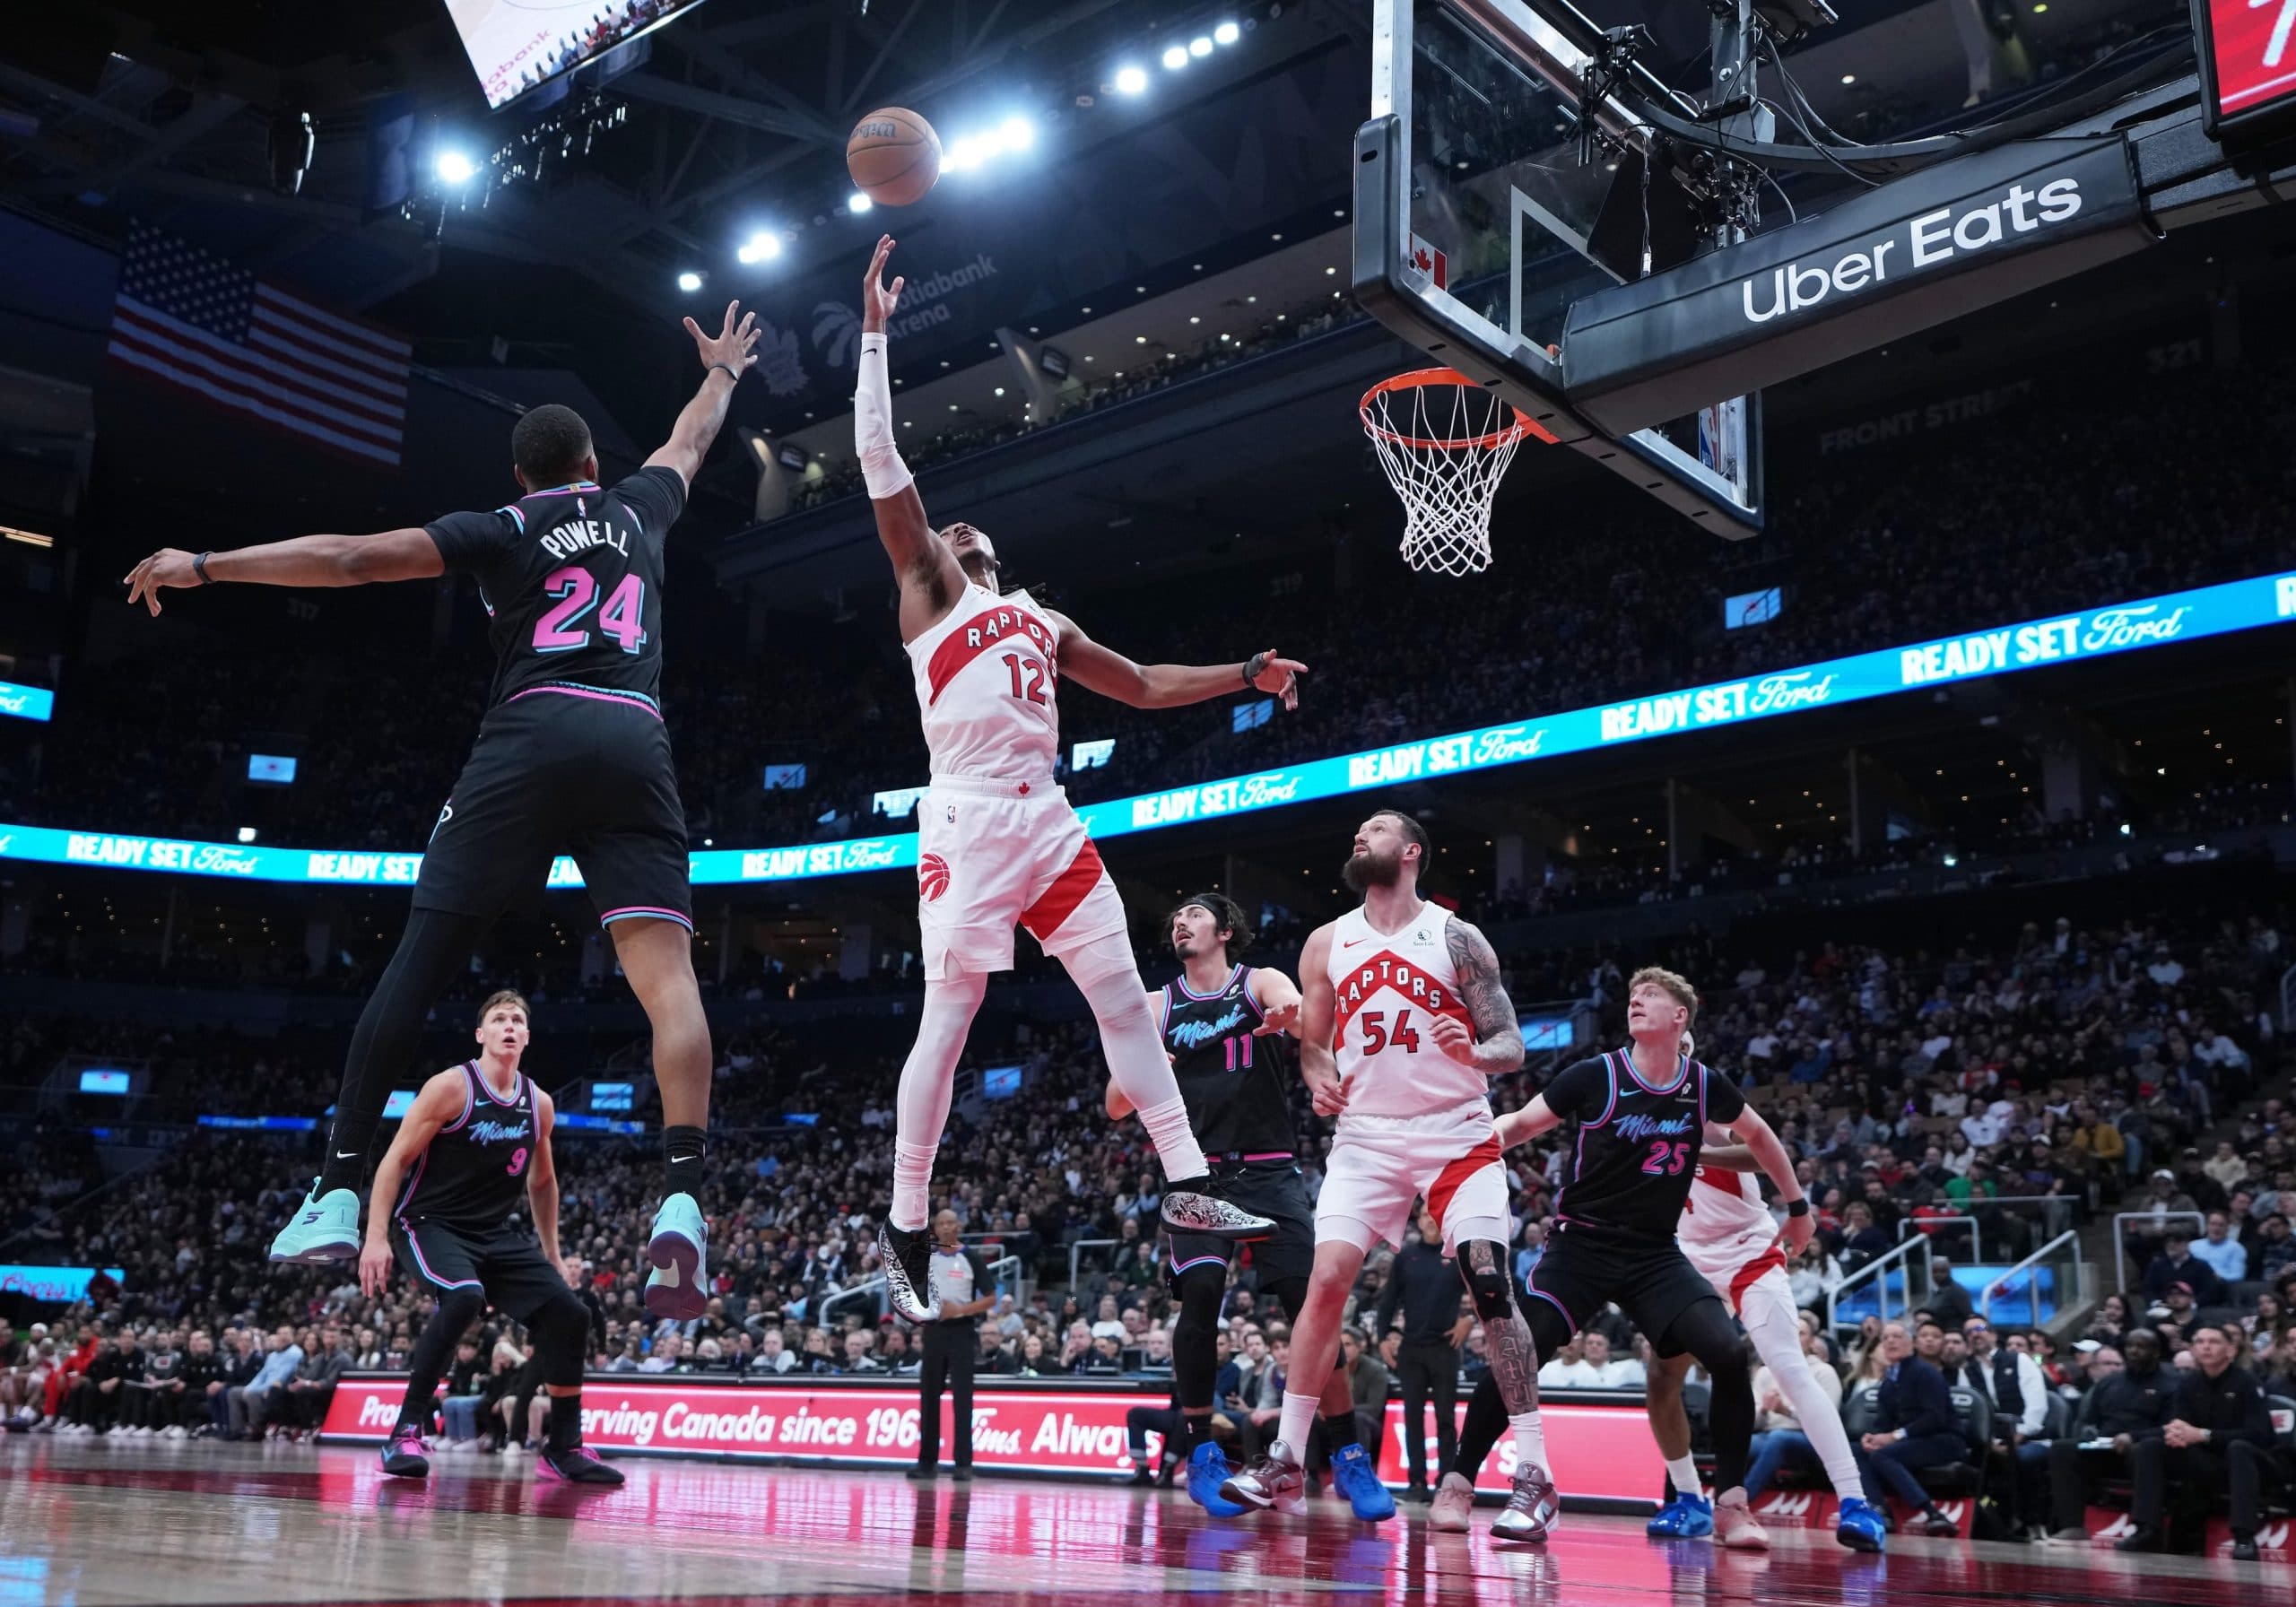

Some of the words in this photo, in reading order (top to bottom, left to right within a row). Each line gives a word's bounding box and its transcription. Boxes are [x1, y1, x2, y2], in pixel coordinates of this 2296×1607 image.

[1743, 239, 1894, 323] Uber
[1909, 178, 2083, 268] Eats
[540, 520, 628, 560] POWELL
[532, 567, 647, 655] 24
[1901, 631, 2011, 685] READY
[2016, 618, 2081, 664] SET
[2083, 604, 2183, 651] Ford
[1002, 654, 1046, 706] 12
[1601, 693, 1692, 741] READY
[1695, 682, 1749, 723] SET
[1750, 672, 1832, 713] Ford
[1349, 744, 1425, 787] READY
[1429, 735, 1474, 771] SET
[1474, 726, 1544, 764] Ford
[1133, 789, 1198, 828] READY
[1200, 781, 1239, 814] SET
[1239, 773, 1299, 807] Ford
[66, 834, 147, 864] READY
[150, 841, 194, 869] SET
[193, 845, 259, 874] Ford
[308, 853, 380, 880] READY
[742, 850, 808, 879] READY
[809, 845, 844, 873] SET
[843, 841, 895, 868] Ford
[1339, 960, 1440, 1014] RAPTORS
[1168, 1004, 1248, 1048] Miami
[1361, 1010, 1420, 1055] 54
[1223, 1033, 1253, 1072] 11
[468, 1119, 529, 1147] Miami
[1613, 1112, 1694, 1143] Miami
[507, 1148, 527, 1177] 9
[1641, 1141, 1691, 1176] 25
[580, 1401, 658, 1445] erving
[663, 1403, 776, 1442] Canada
[778, 1406, 857, 1445] since
